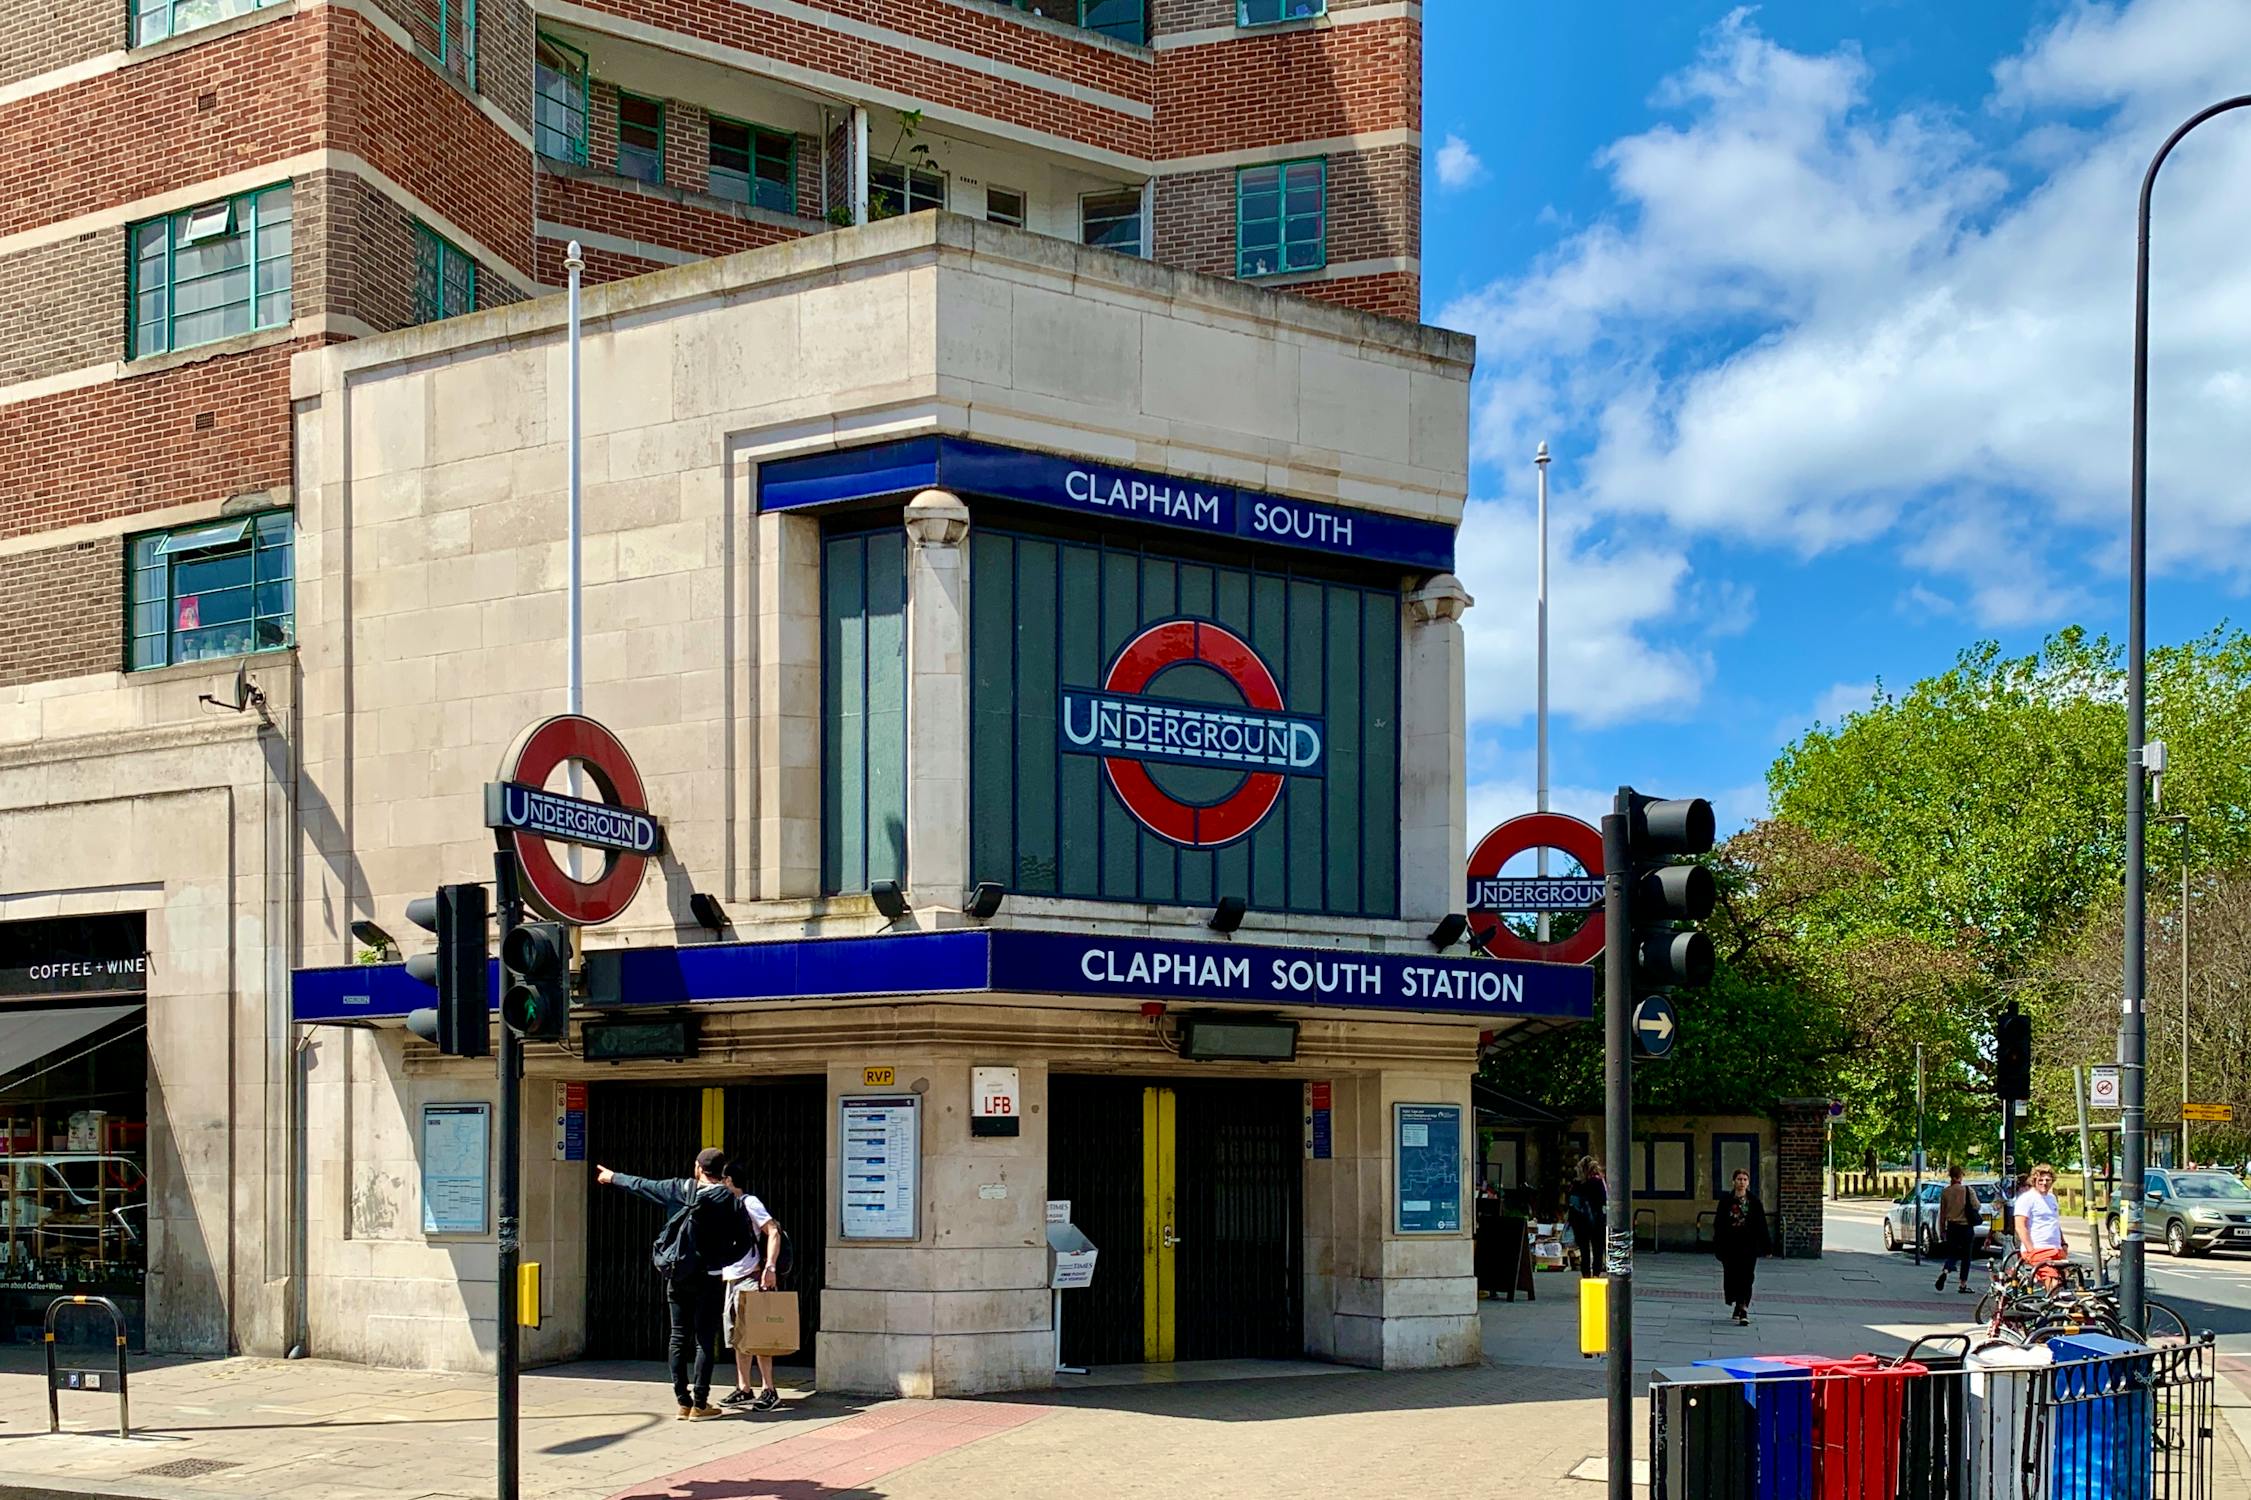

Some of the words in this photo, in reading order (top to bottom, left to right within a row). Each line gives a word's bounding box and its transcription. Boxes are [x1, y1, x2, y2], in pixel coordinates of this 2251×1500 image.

[1065, 470, 1219, 525] CLAPHAM
[1253, 502, 1353, 546] SOUTH
[1063, 696, 1321, 769] UNDERGROUND
[505, 787, 654, 851] UNDERGROUND
[1467, 881, 1606, 909] UNDERGROUN
[29, 961, 92, 980] COFFEE
[106, 957, 146, 975] WINE
[1081, 948, 1250, 989] CLAPHAM
[1271, 958, 1382, 995] SOUTH
[1401, 966, 1524, 1003] STATION
[866, 1070, 892, 1083] RVP
[984, 1096, 1012, 1115] LFB
[1049, 1203, 1069, 1211] TIMES
